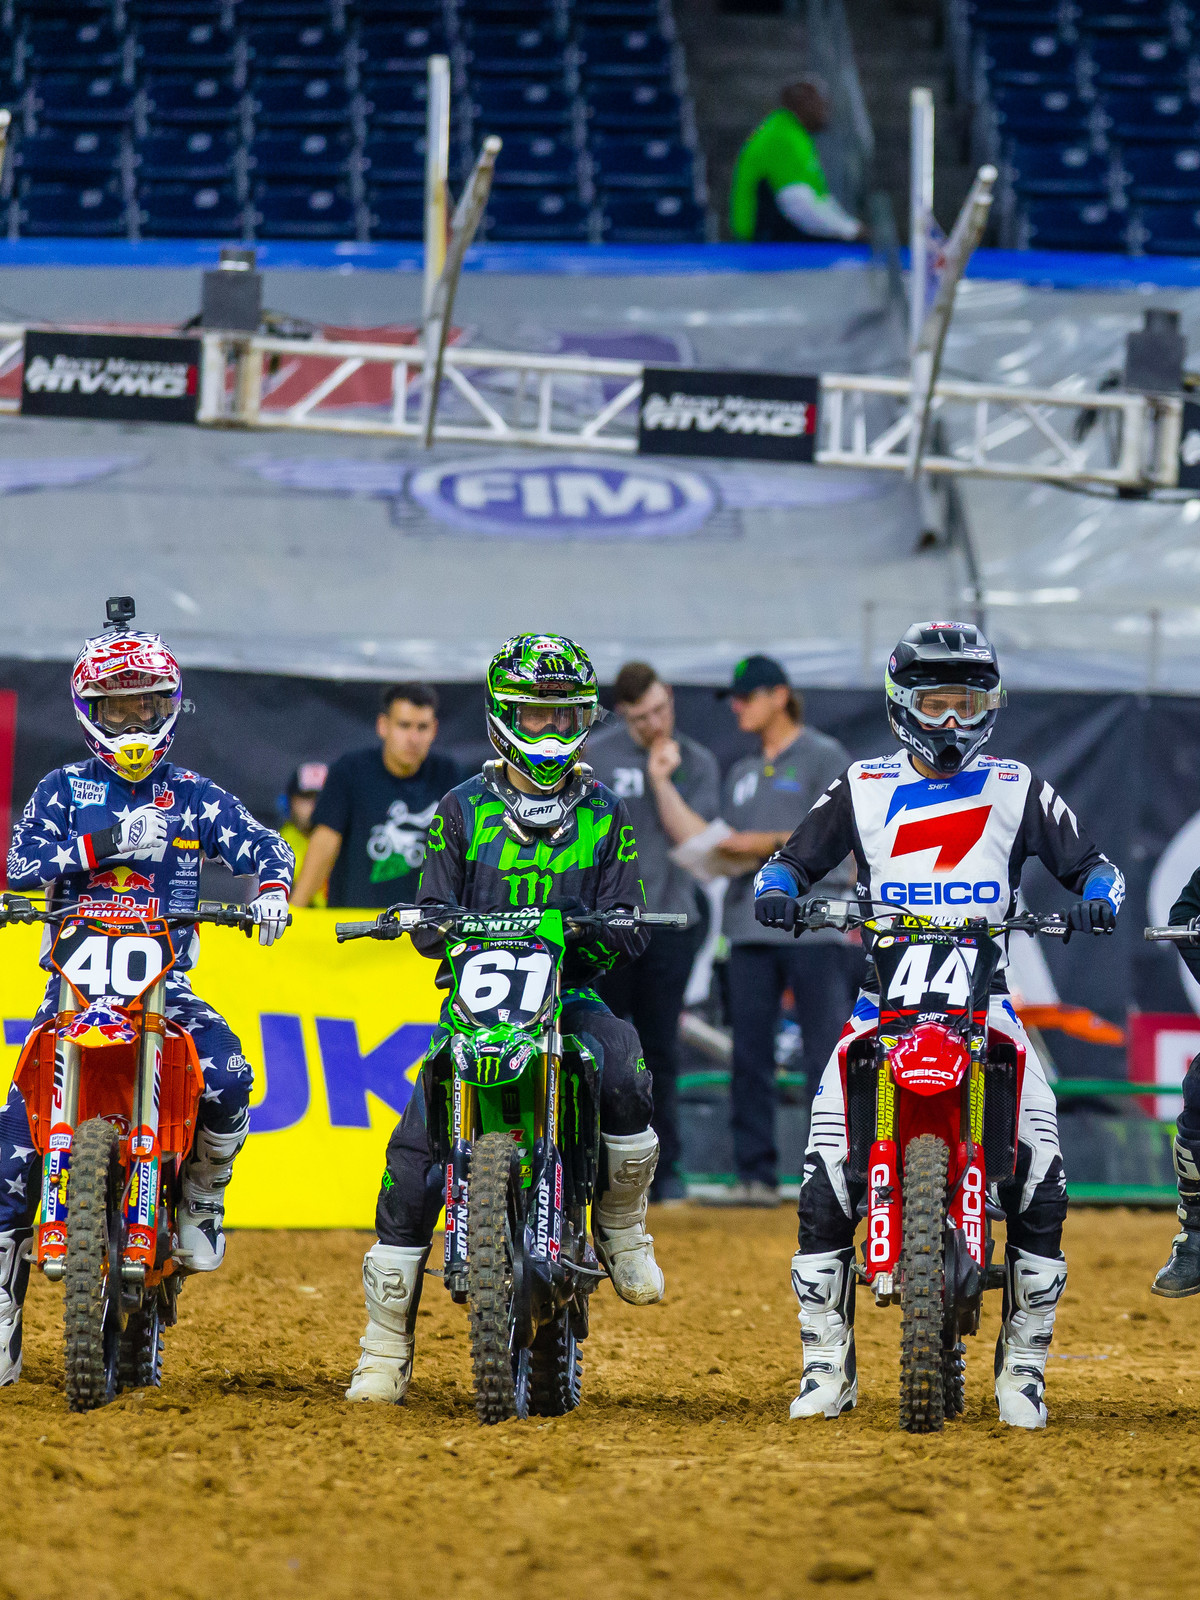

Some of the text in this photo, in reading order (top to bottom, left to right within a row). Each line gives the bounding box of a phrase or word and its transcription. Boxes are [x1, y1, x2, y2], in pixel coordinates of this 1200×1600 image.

[456, 472, 672, 519] FIM
[860, 762, 902, 770] GEICO
[977, 760, 1020, 771] GEICO
[998, 773, 1019, 782] 100%
[927, 783, 950, 791] SHIFT
[522, 803, 557, 818] LEATT
[880, 880, 1001, 905] GEICO
[83, 909, 149, 919] RENTHAL
[461, 919, 541, 933] RENTHA
[489, 940, 530, 948] MONSTER
[918, 933, 960, 943] MONSTR
[61, 935, 163, 997] 40
[458, 949, 552, 1014] 61
[887, 943, 979, 1007] 44
[916, 1011, 949, 1023] SHIFT
[901, 1068, 954, 1081] GEICO
[908, 1079, 947, 1087] HONDA
[536, 1177, 550, 1258] DUNLOP
[961, 1166, 983, 1266] GEICO
